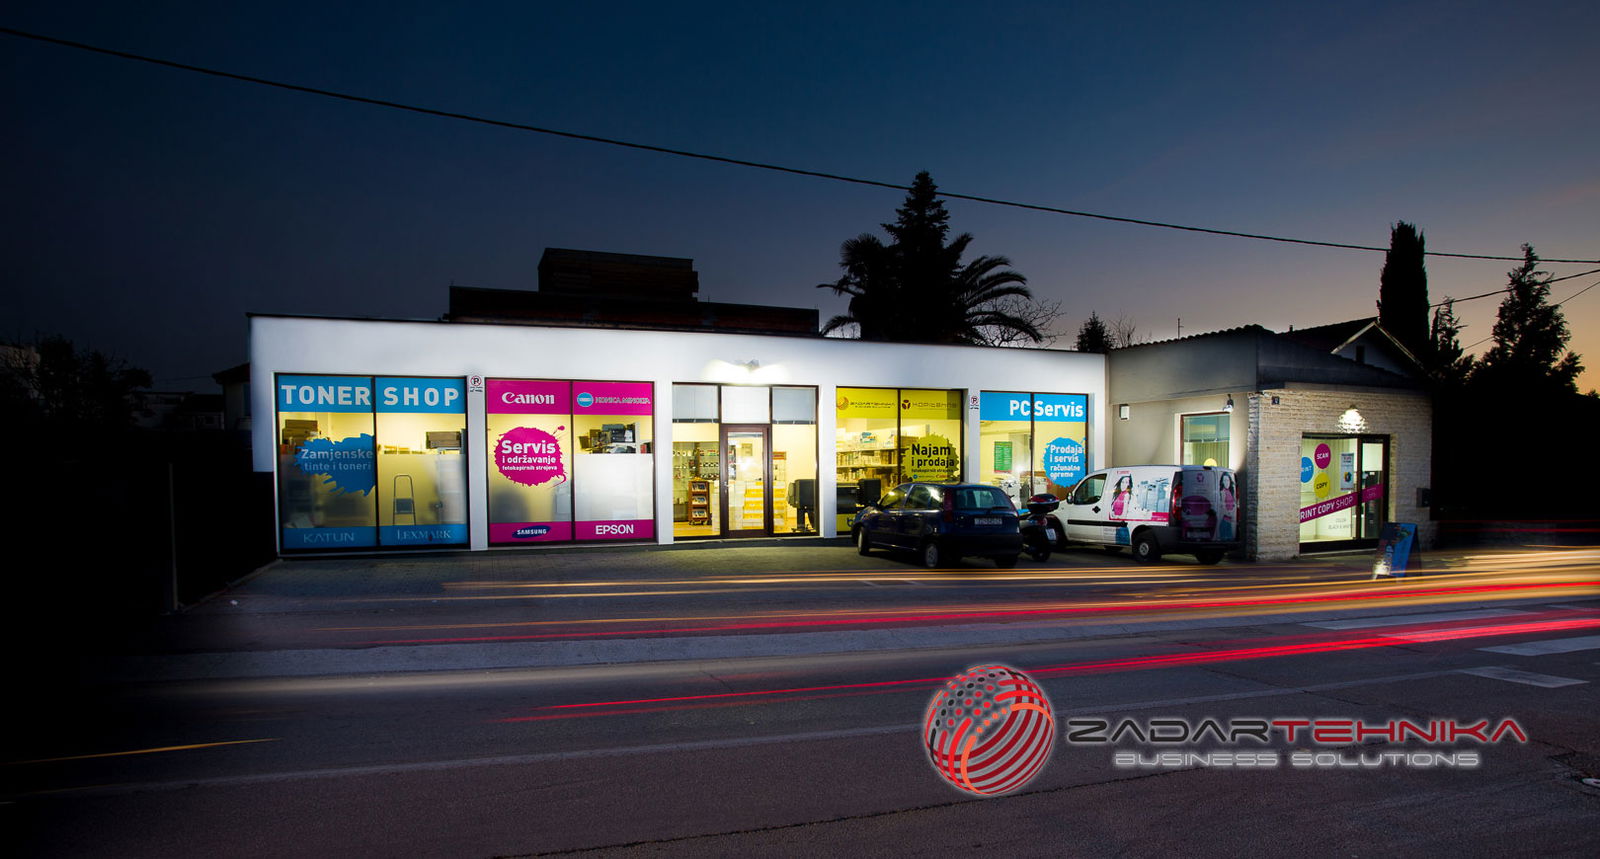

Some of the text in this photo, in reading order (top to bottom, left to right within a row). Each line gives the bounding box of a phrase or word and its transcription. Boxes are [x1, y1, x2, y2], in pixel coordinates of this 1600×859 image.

[281, 384, 459, 407] TONER SHOP
[501, 391, 555, 405] Canon
[1009, 399, 1084, 417] PC Servis
[501, 439, 556, 454] Servis
[911, 443, 951, 458] Najam
[1050, 444, 1083, 455] Prodaja
[301, 448, 373, 461] Zamjenske
[502, 454, 557, 465] i održavanje
[1054, 454, 1079, 463] servis
[1316, 452, 1329, 460] SCAN
[304, 462, 330, 471] tinte
[338, 462, 372, 471] toneri
[911, 457, 955, 468] i prodaja
[1316, 481, 1328, 489] COPY
[1300, 496, 1353, 520] RINT COPY SHOP
[397, 529, 451, 541] LEXMARK
[595, 524, 634, 535] EPSON
[303, 532, 355, 543] KATUN
